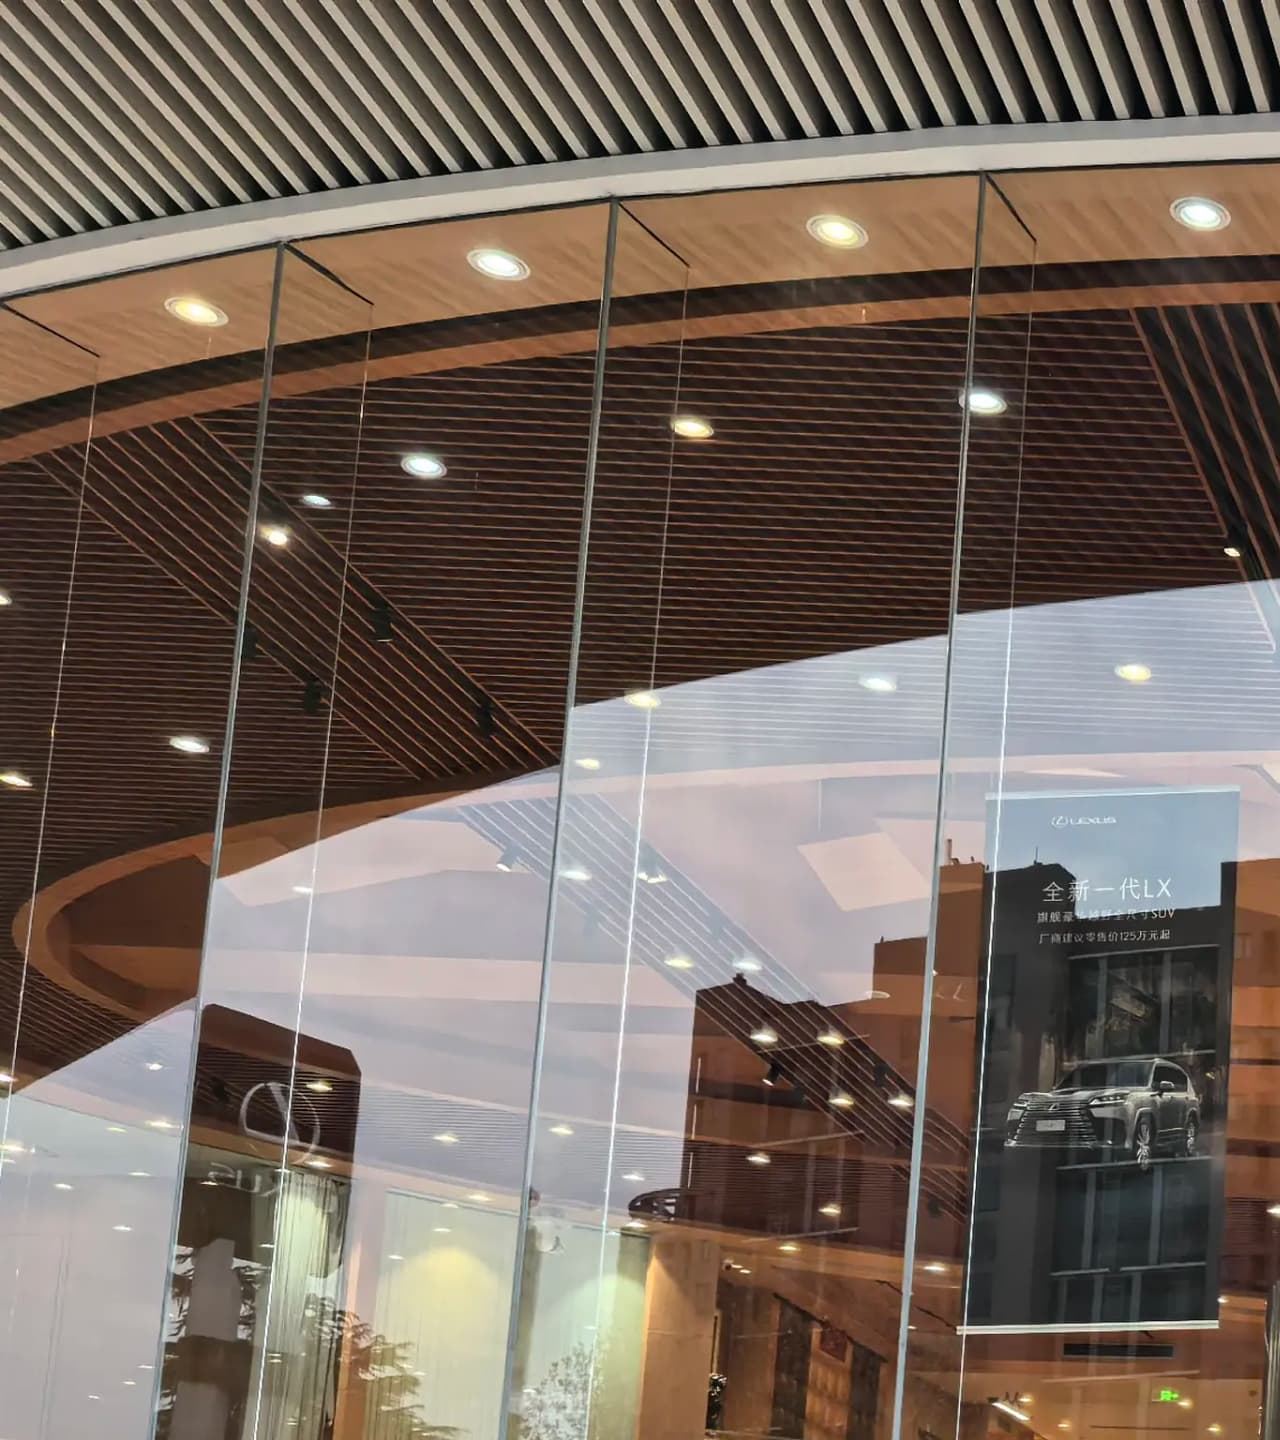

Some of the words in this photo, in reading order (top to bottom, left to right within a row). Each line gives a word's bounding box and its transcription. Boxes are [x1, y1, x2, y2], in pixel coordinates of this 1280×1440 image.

[1070, 816, 1117, 825] LEXUS
[1042, 877, 1172, 902] 全新一代LX
